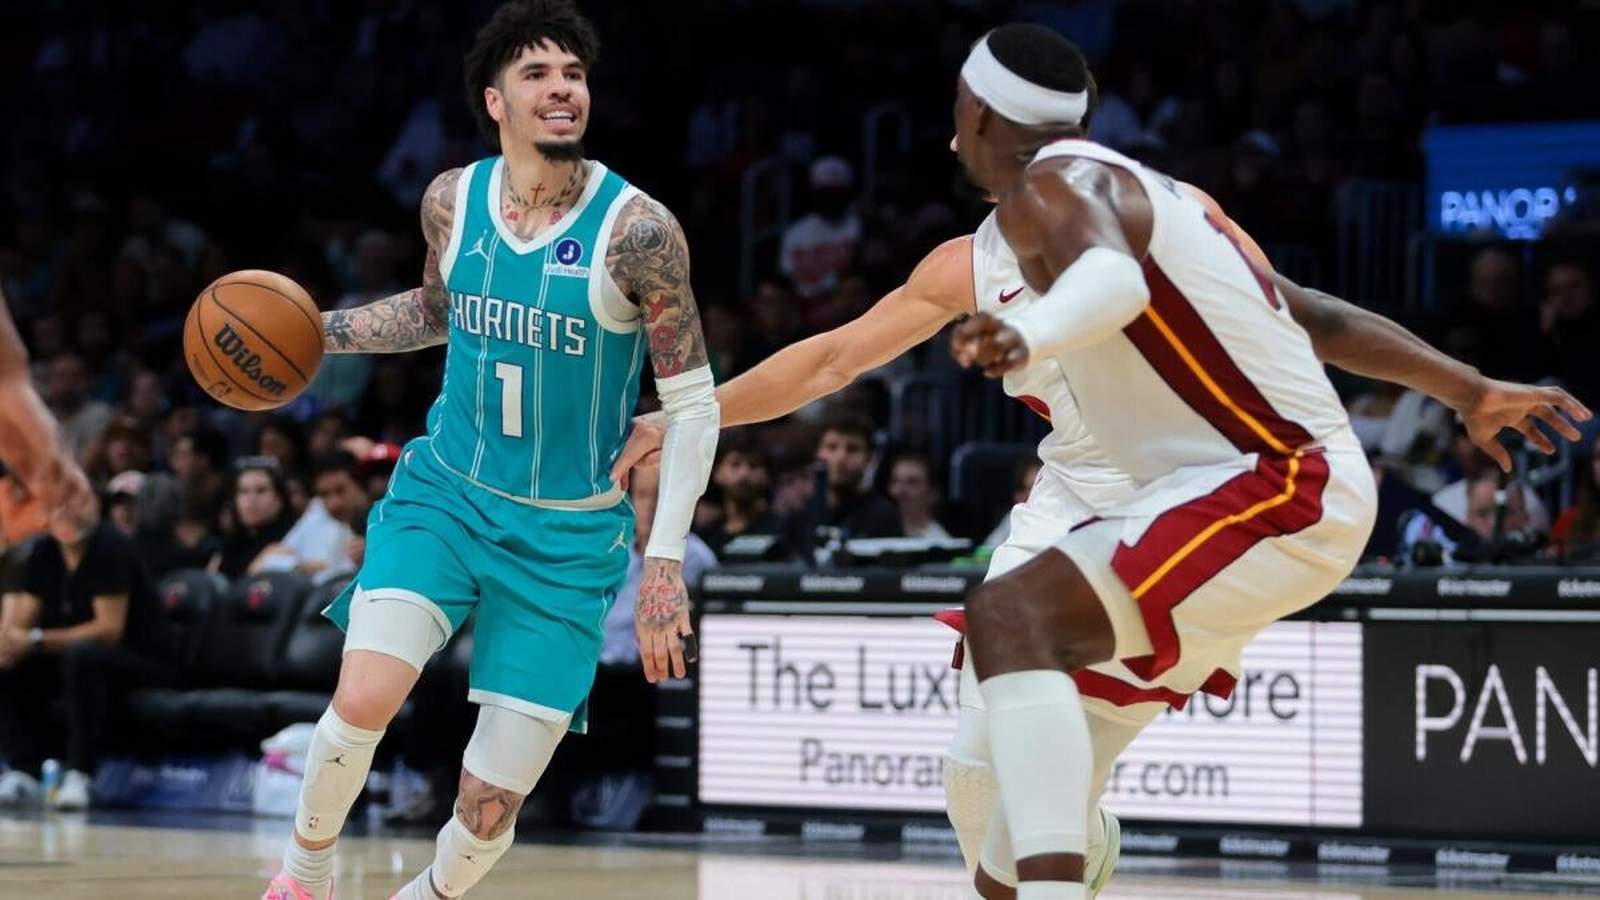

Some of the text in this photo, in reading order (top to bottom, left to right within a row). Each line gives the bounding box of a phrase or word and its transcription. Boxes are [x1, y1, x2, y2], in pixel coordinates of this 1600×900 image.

[214, 321, 288, 397] Wilson
[450, 290, 588, 356] HORNETS
[494, 360, 525, 439] 1
[736, 636, 1300, 721] The Lux ore
[1415, 663, 1599, 768] PAN
